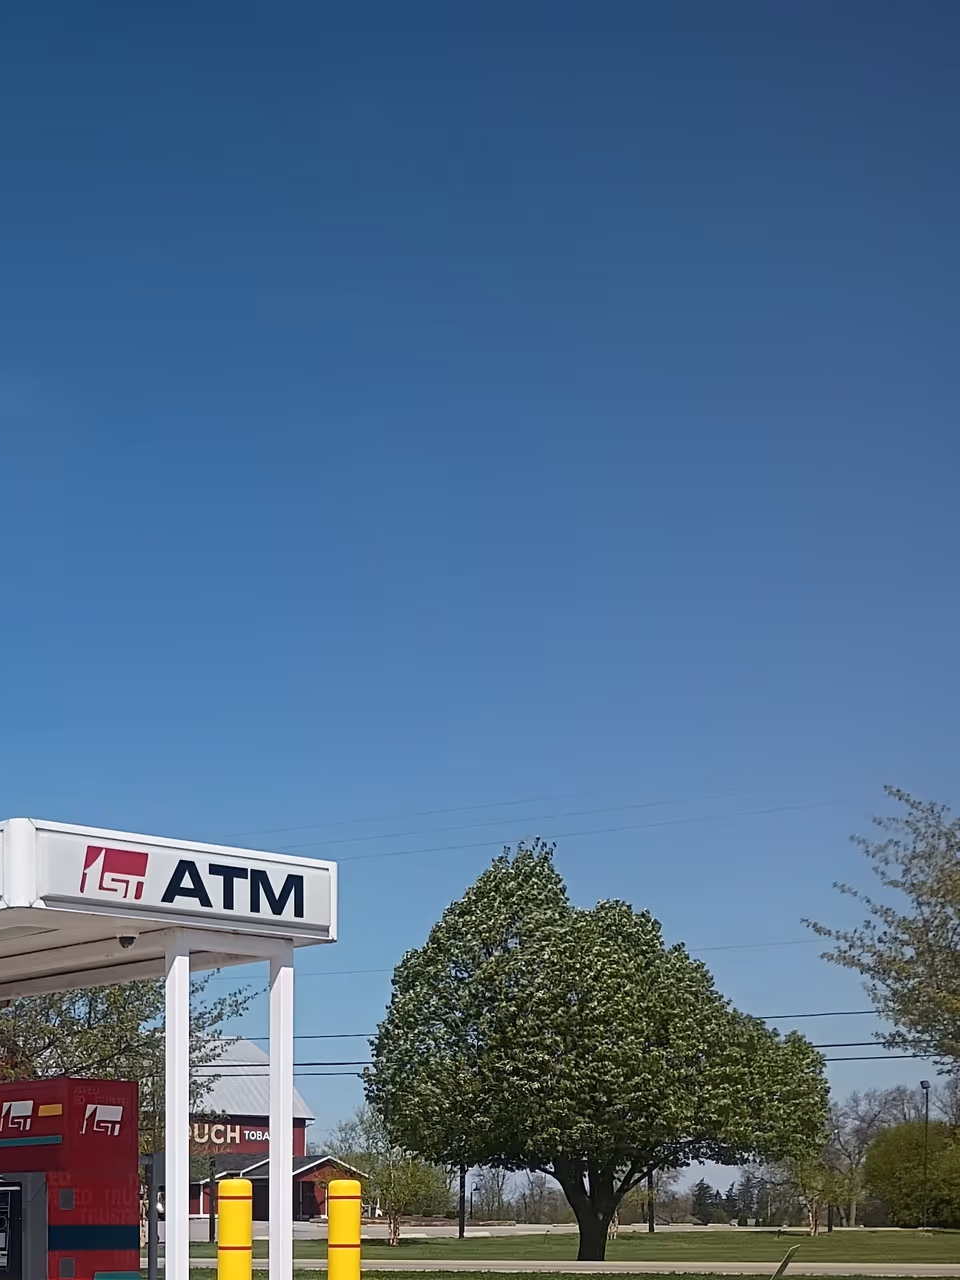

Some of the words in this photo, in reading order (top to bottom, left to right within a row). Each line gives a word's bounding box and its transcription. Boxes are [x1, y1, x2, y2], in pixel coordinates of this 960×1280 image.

[161, 859, 304, 918] ATM
[189, 1123, 240, 1144] UCH
[243, 1131, 270, 1141] TOBA
